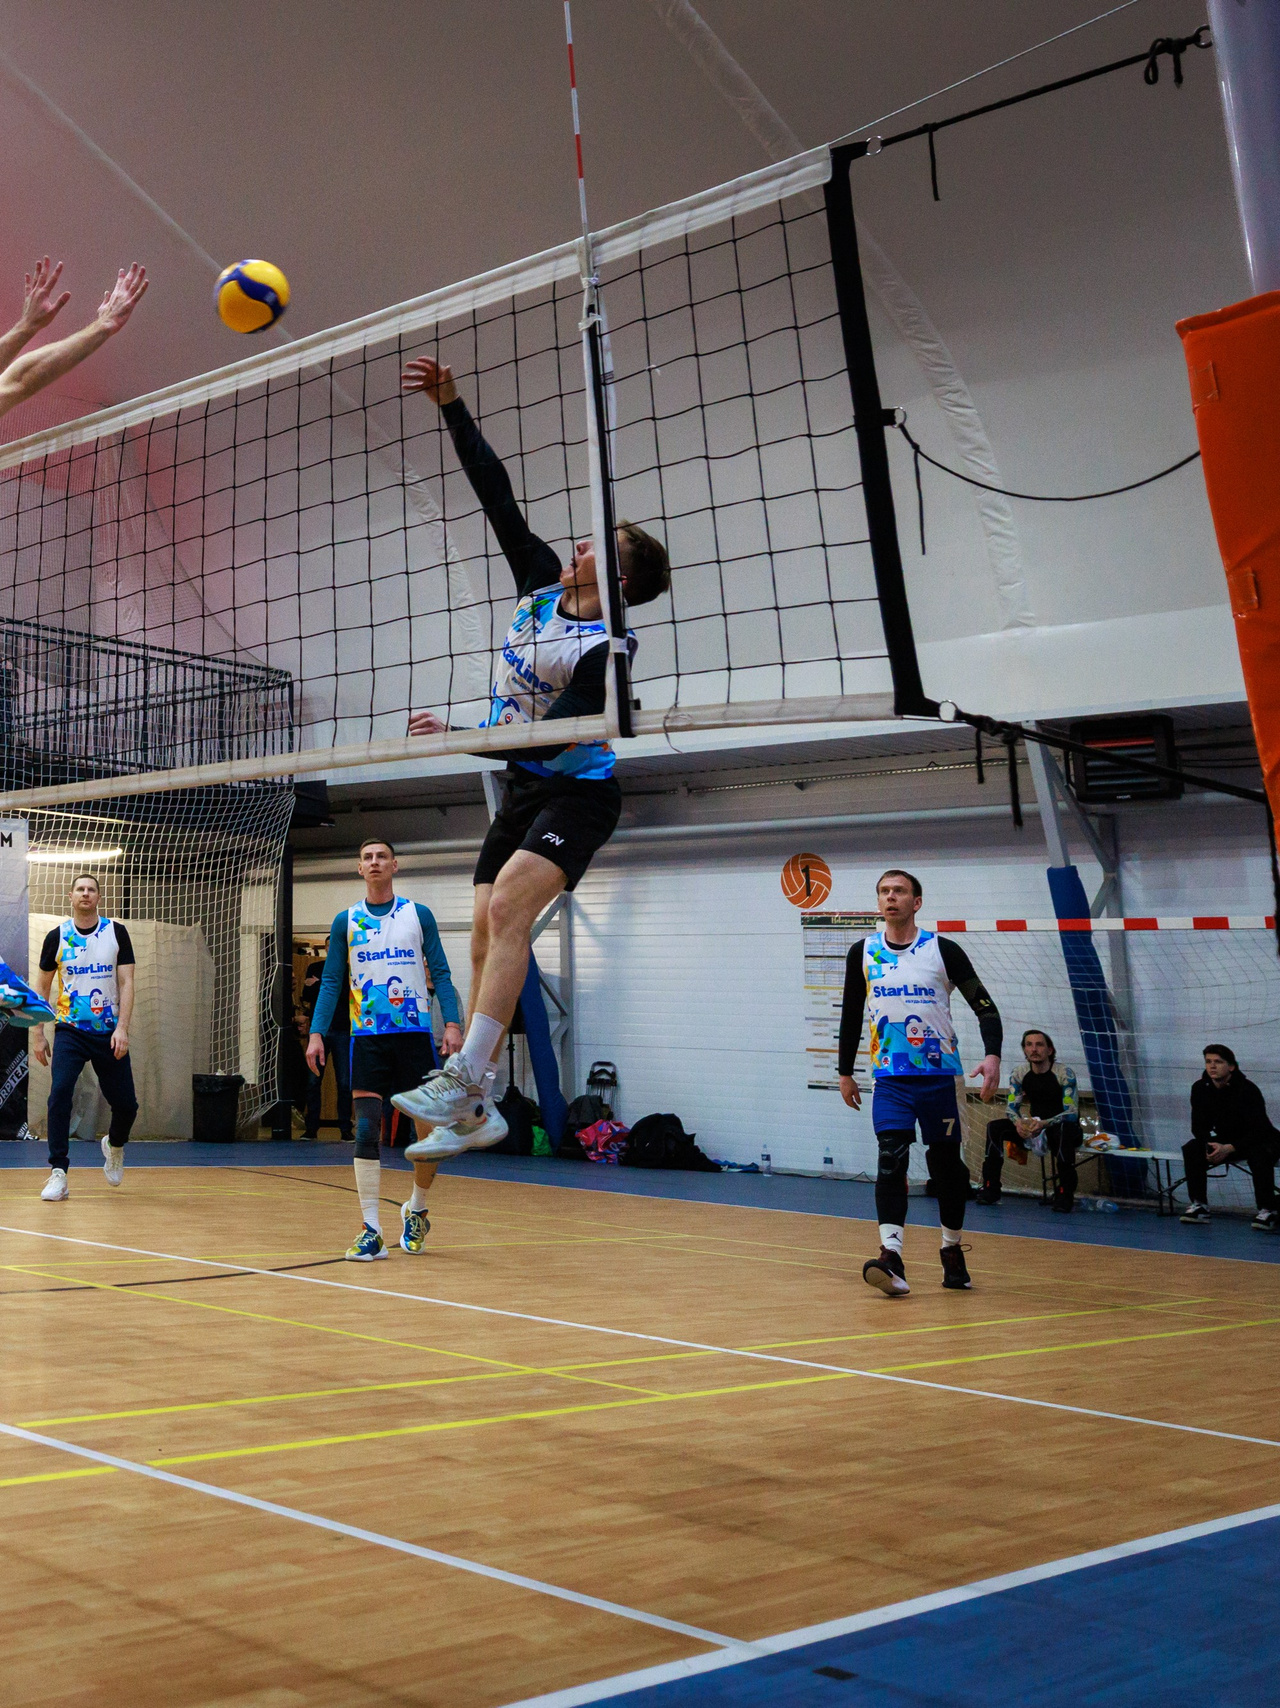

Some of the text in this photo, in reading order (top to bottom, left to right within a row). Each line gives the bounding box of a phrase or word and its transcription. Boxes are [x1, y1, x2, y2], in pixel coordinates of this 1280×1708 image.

[801, 865, 812, 896] 1
[357, 947, 415, 963] StarLine
[66, 962, 114, 976] StarLine
[873, 984, 936, 999] StarLine
[942, 1118, 955, 1136] 7
